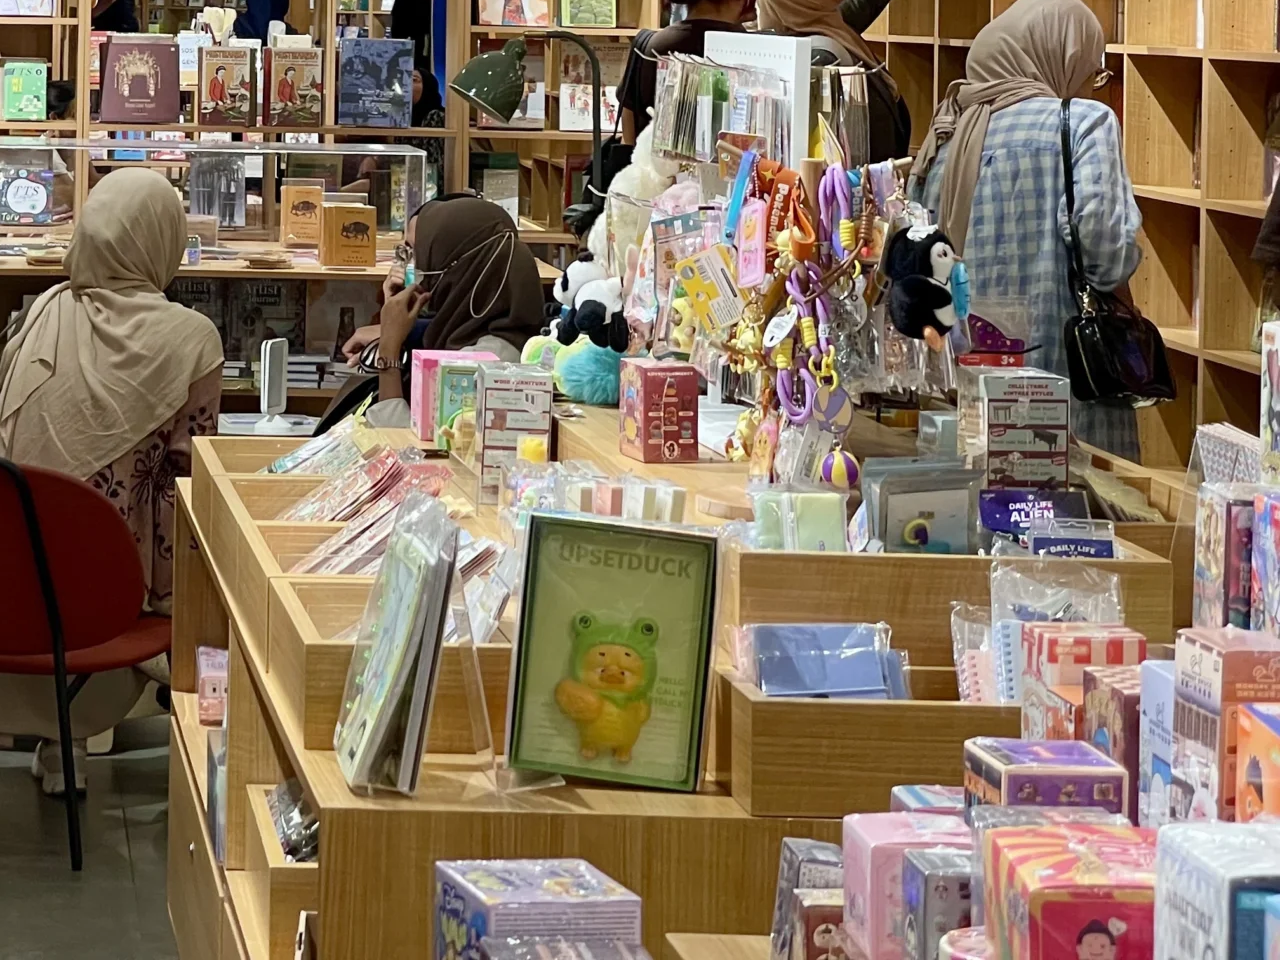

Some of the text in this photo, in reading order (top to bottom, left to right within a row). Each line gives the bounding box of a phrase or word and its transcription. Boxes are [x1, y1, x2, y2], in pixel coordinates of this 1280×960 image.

[11, 67, 34, 76] TTS
[13, 186, 40, 196] TTS
[173, 279, 216, 291] Artist's
[243, 283, 287, 296] Artist's
[248, 295, 281, 304] Journey
[1000, 355, 1015, 365] 3+
[1009, 501, 1053, 511] DAILY LIFE
[1010, 509, 1055, 522] ALIEN
[1050, 544, 1096, 554] DAILY LIFE
[558, 542, 694, 580] UPSETDUCK
